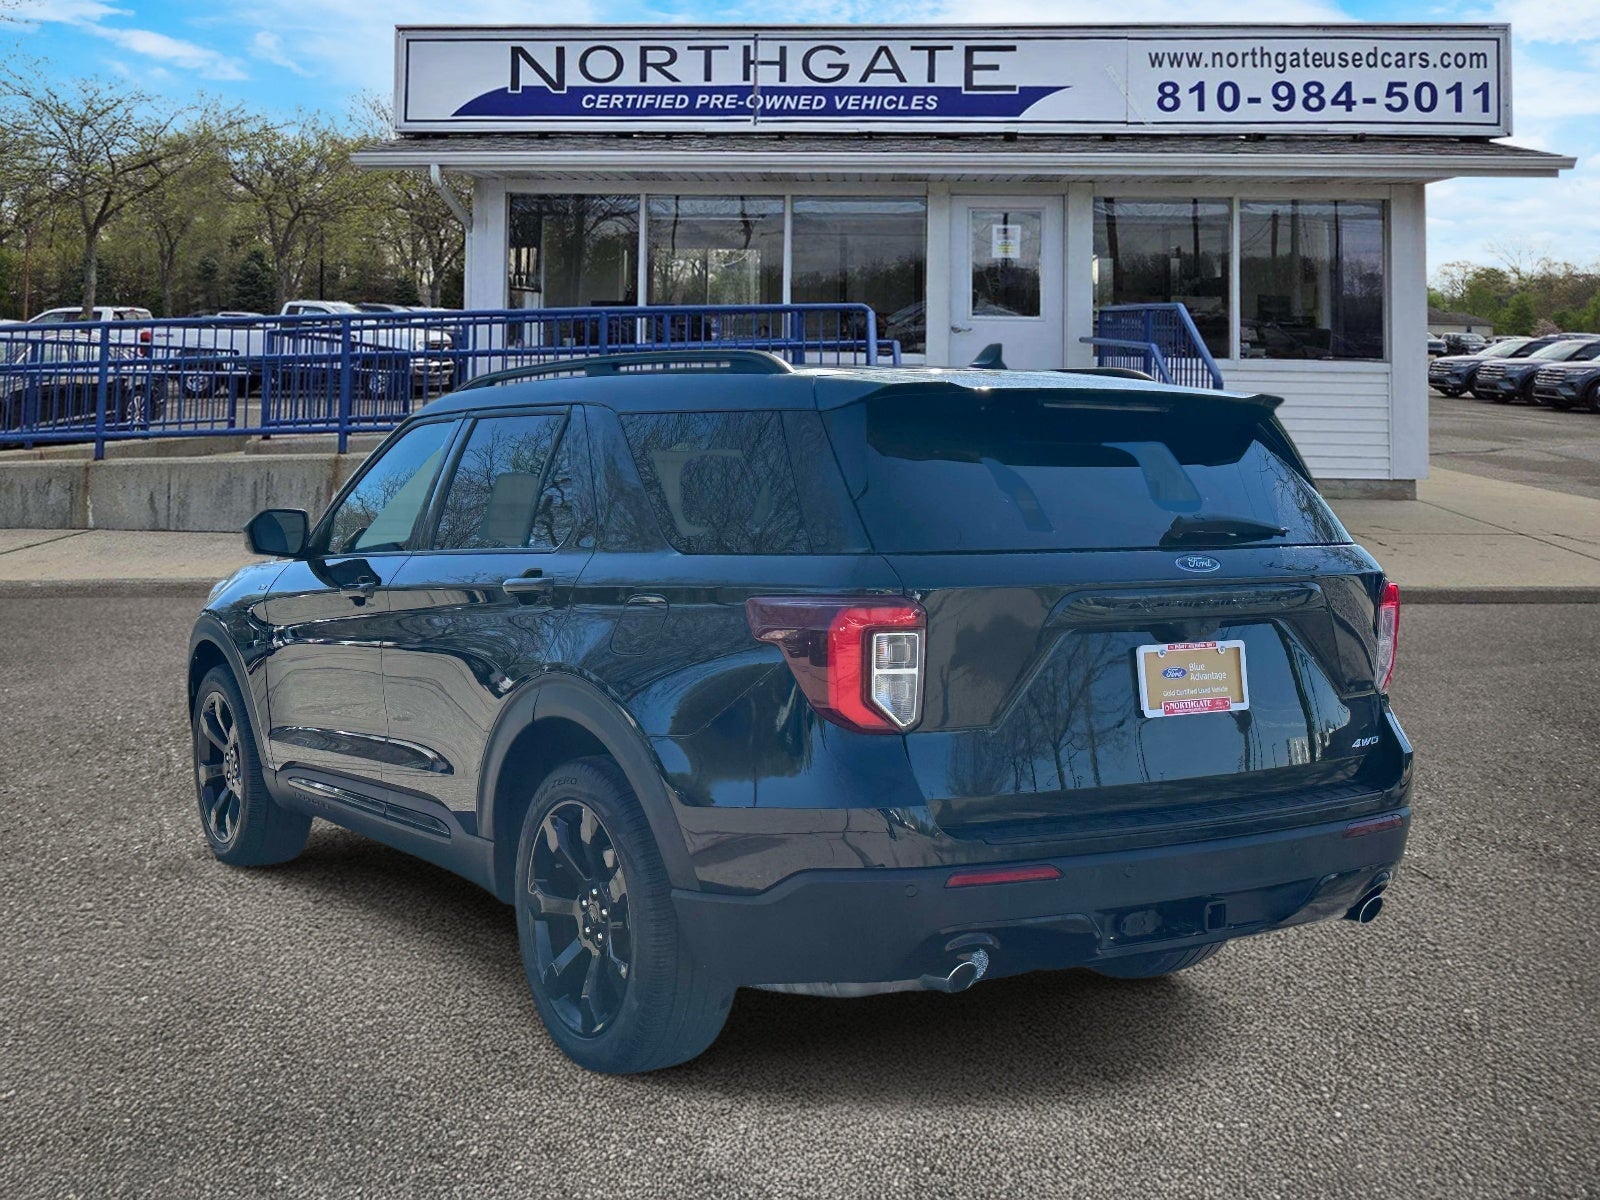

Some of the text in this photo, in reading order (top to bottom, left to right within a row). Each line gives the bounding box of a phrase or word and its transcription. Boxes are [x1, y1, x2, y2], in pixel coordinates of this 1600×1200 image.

[510, 44, 1017, 93] NORTHGATE
[1148, 46, 1489, 73] www.northgateusedcars.com
[581, 93, 938, 111] CERTIFIED PRE-OWNED VEHICLES
[1156, 80, 1491, 113] 810-984-5011
[1188, 662, 1206, 672] Blue
[1190, 671, 1227, 681] Advantage
[1351, 735, 1379, 748] 4WD
